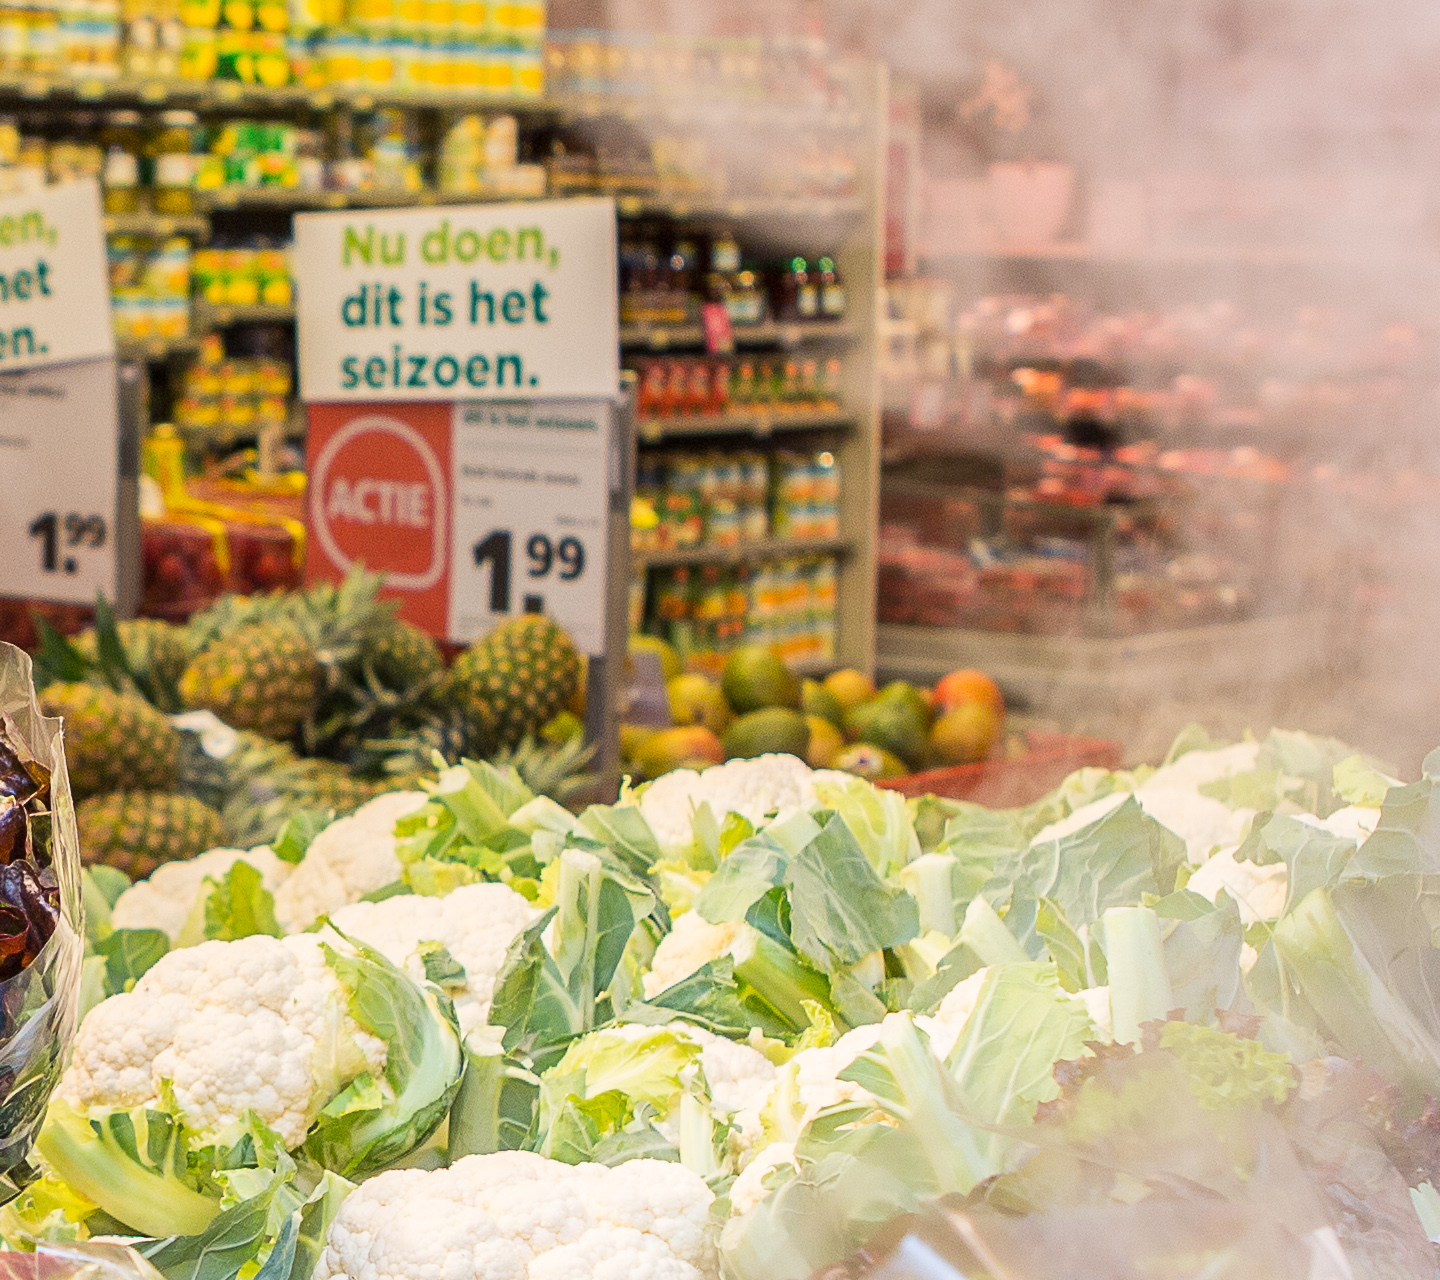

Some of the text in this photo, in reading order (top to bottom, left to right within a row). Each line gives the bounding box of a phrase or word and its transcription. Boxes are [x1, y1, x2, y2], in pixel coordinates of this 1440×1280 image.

[341, 219, 561, 270] Nu doen,
[341, 278, 550, 328] dit is het
[341, 342, 539, 390] seizoen.
[328, 477, 430, 530] ACTIE
